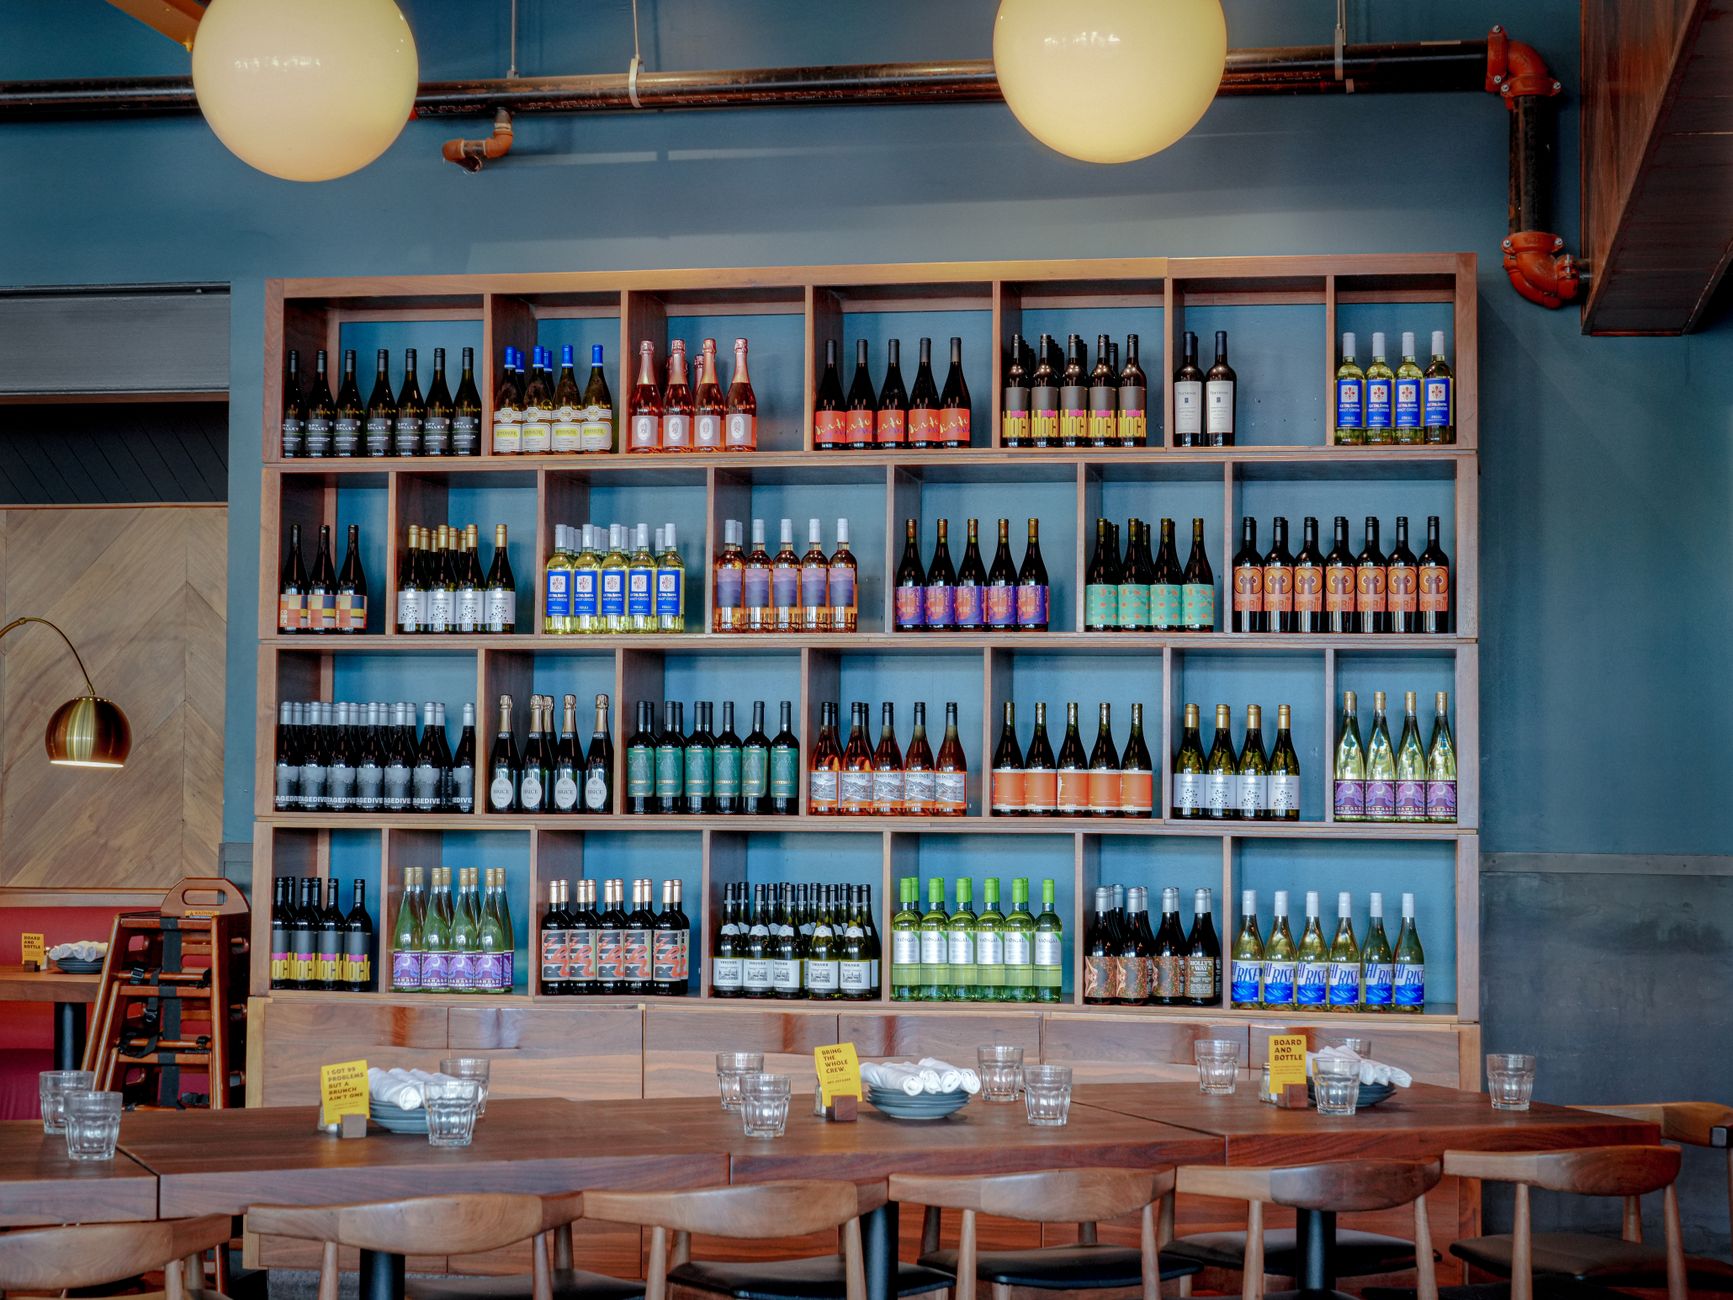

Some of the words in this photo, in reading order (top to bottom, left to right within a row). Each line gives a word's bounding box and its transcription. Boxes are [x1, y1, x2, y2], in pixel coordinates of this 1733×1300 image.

[825, 1059, 848, 1067] WHOLE
[328, 1073, 364, 1081] PROBLEMS
[329, 1087, 357, 1095] BRUNCH
